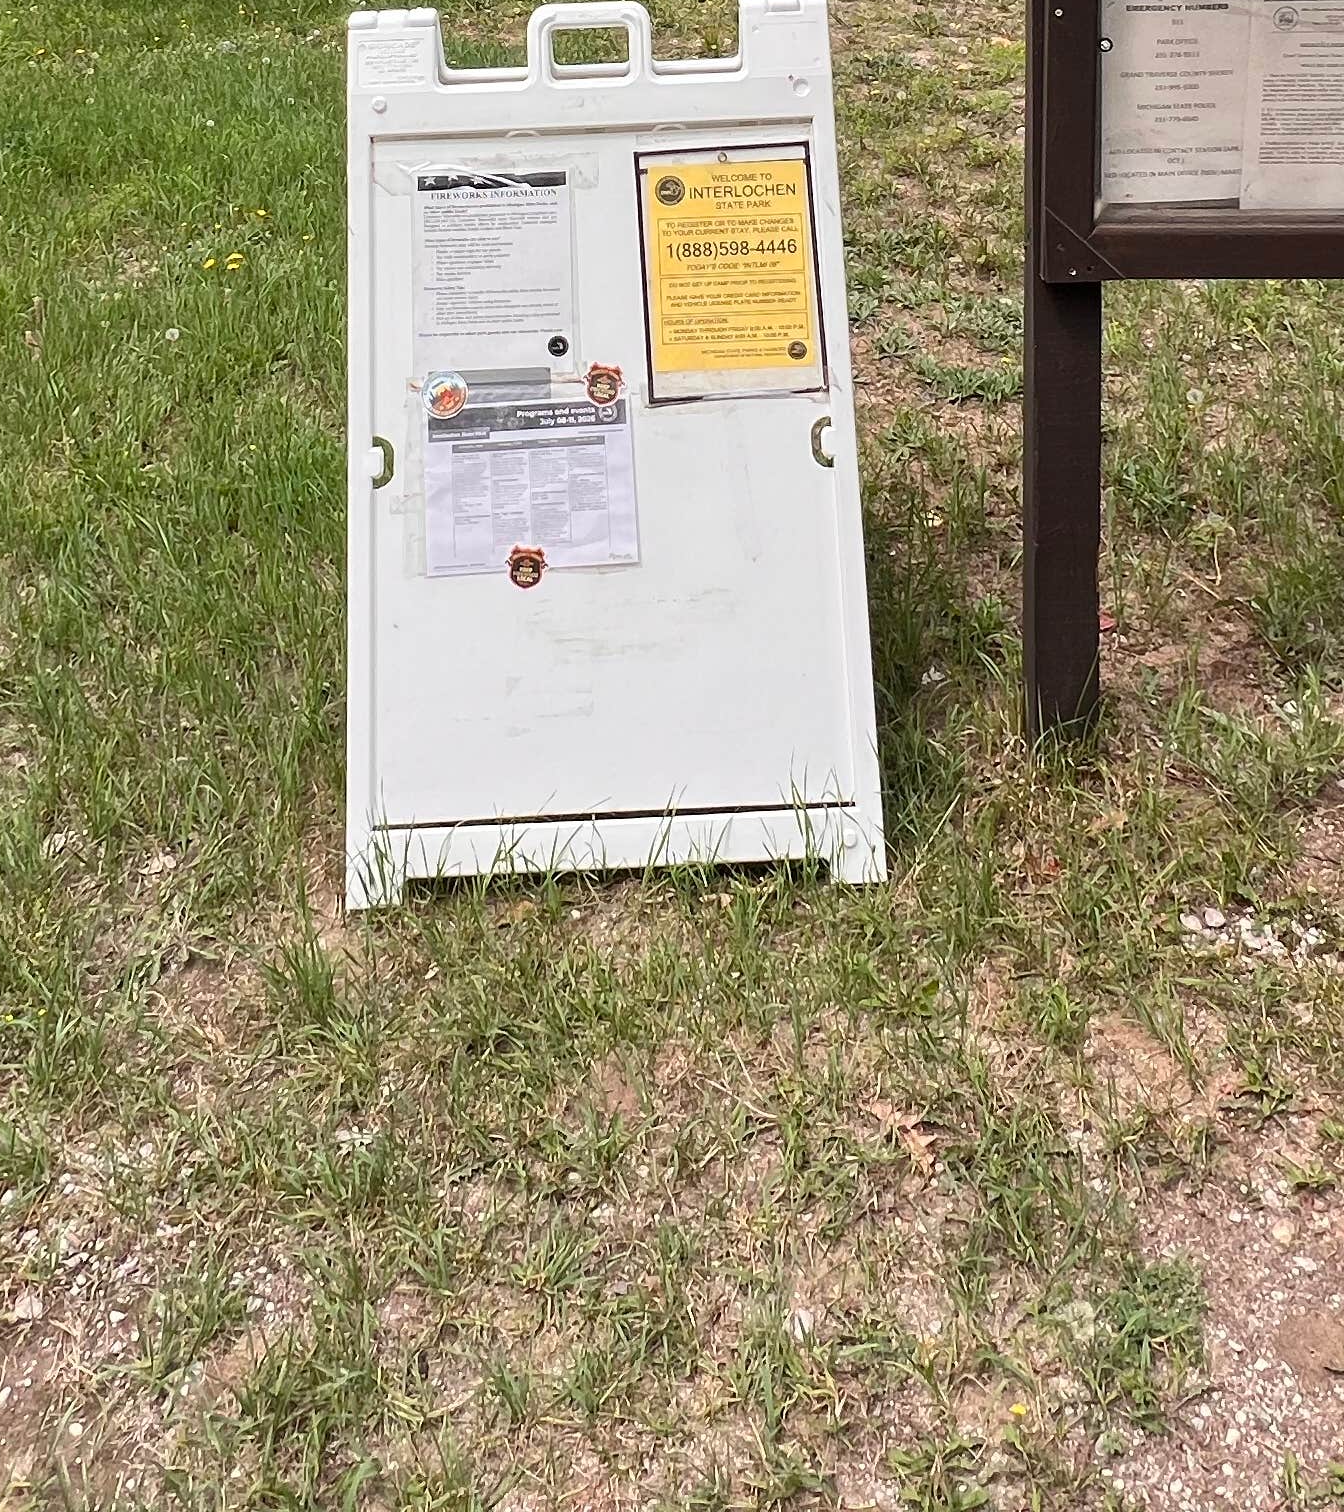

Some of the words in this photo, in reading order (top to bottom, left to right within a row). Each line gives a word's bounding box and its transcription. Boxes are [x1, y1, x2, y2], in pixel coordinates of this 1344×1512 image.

[712, 174, 757, 182] WELCOME
[760, 173, 772, 181] TO
[431, 190, 488, 201] FIREWORKS
[490, 188, 557, 198] INFORMATION
[689, 183, 796, 199] INTERLOCHEN
[715, 201, 744, 210] STATE
[746, 200, 771, 209] PARK
[673, 229, 693, 237] YOUR
[695, 228, 729, 236] CURRENT
[666, 239, 797, 260] 1(888)598-4446
[555, 407, 569, 415] and
